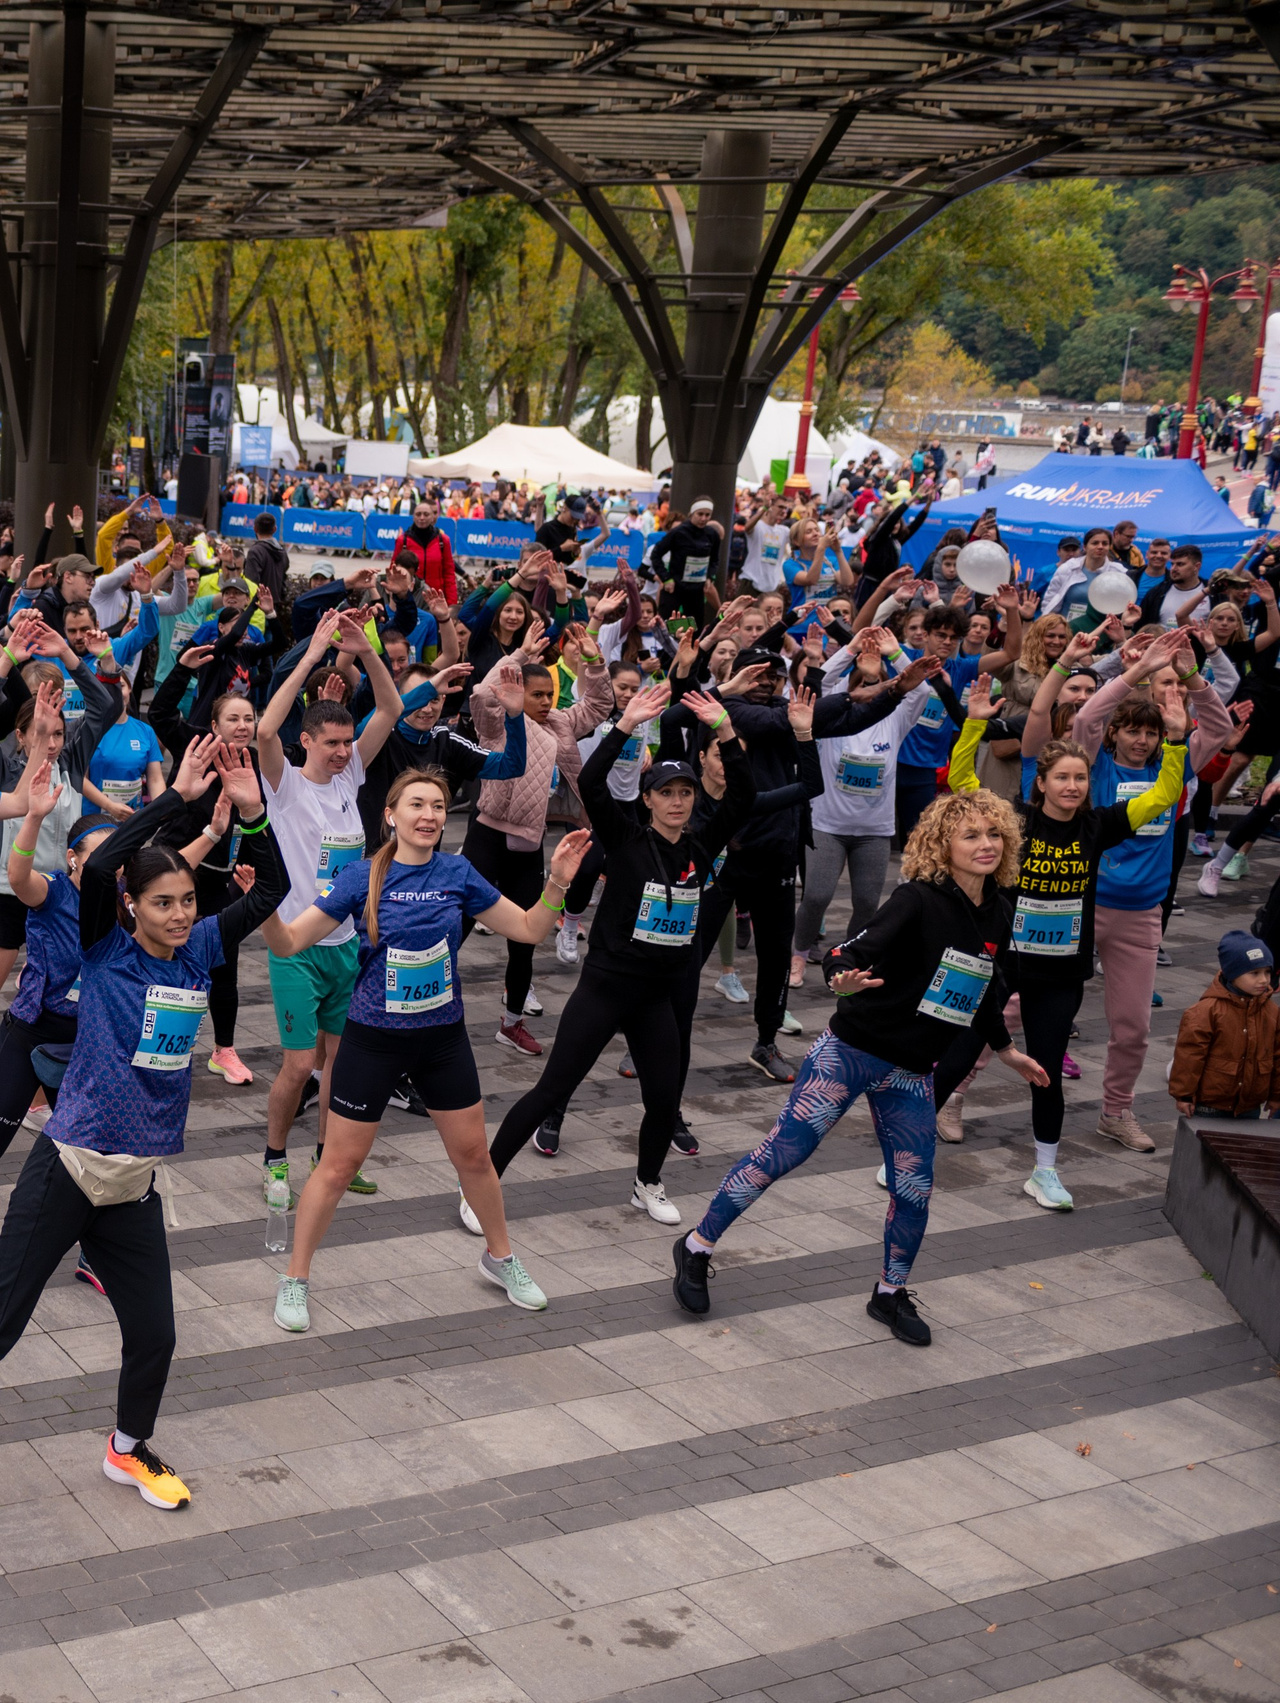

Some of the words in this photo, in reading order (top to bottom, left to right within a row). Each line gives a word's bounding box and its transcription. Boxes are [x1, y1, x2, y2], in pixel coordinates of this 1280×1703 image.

[1005, 482, 1067, 501] RUN
[1061, 483, 1164, 504] UKRAINE
[229, 516, 244, 526] RUN
[293, 522, 313, 533] RUN
[313, 522, 353, 536] UKRAINE
[377, 528, 399, 540] RUN
[467, 533, 488, 545] RUN
[68, 700, 86, 710] 740
[846, 774, 871, 788] 7305
[1047, 841, 1081, 859] FREE
[1022, 857, 1090, 874] AZOVSTAL
[389, 890, 447, 901] SERVIER
[652, 918, 686, 934] 7583
[1027, 929, 1064, 944] 7017
[403, 980, 439, 1001] 7628
[941, 988, 974, 1012] 7586
[155, 1033, 191, 1054] 7625
